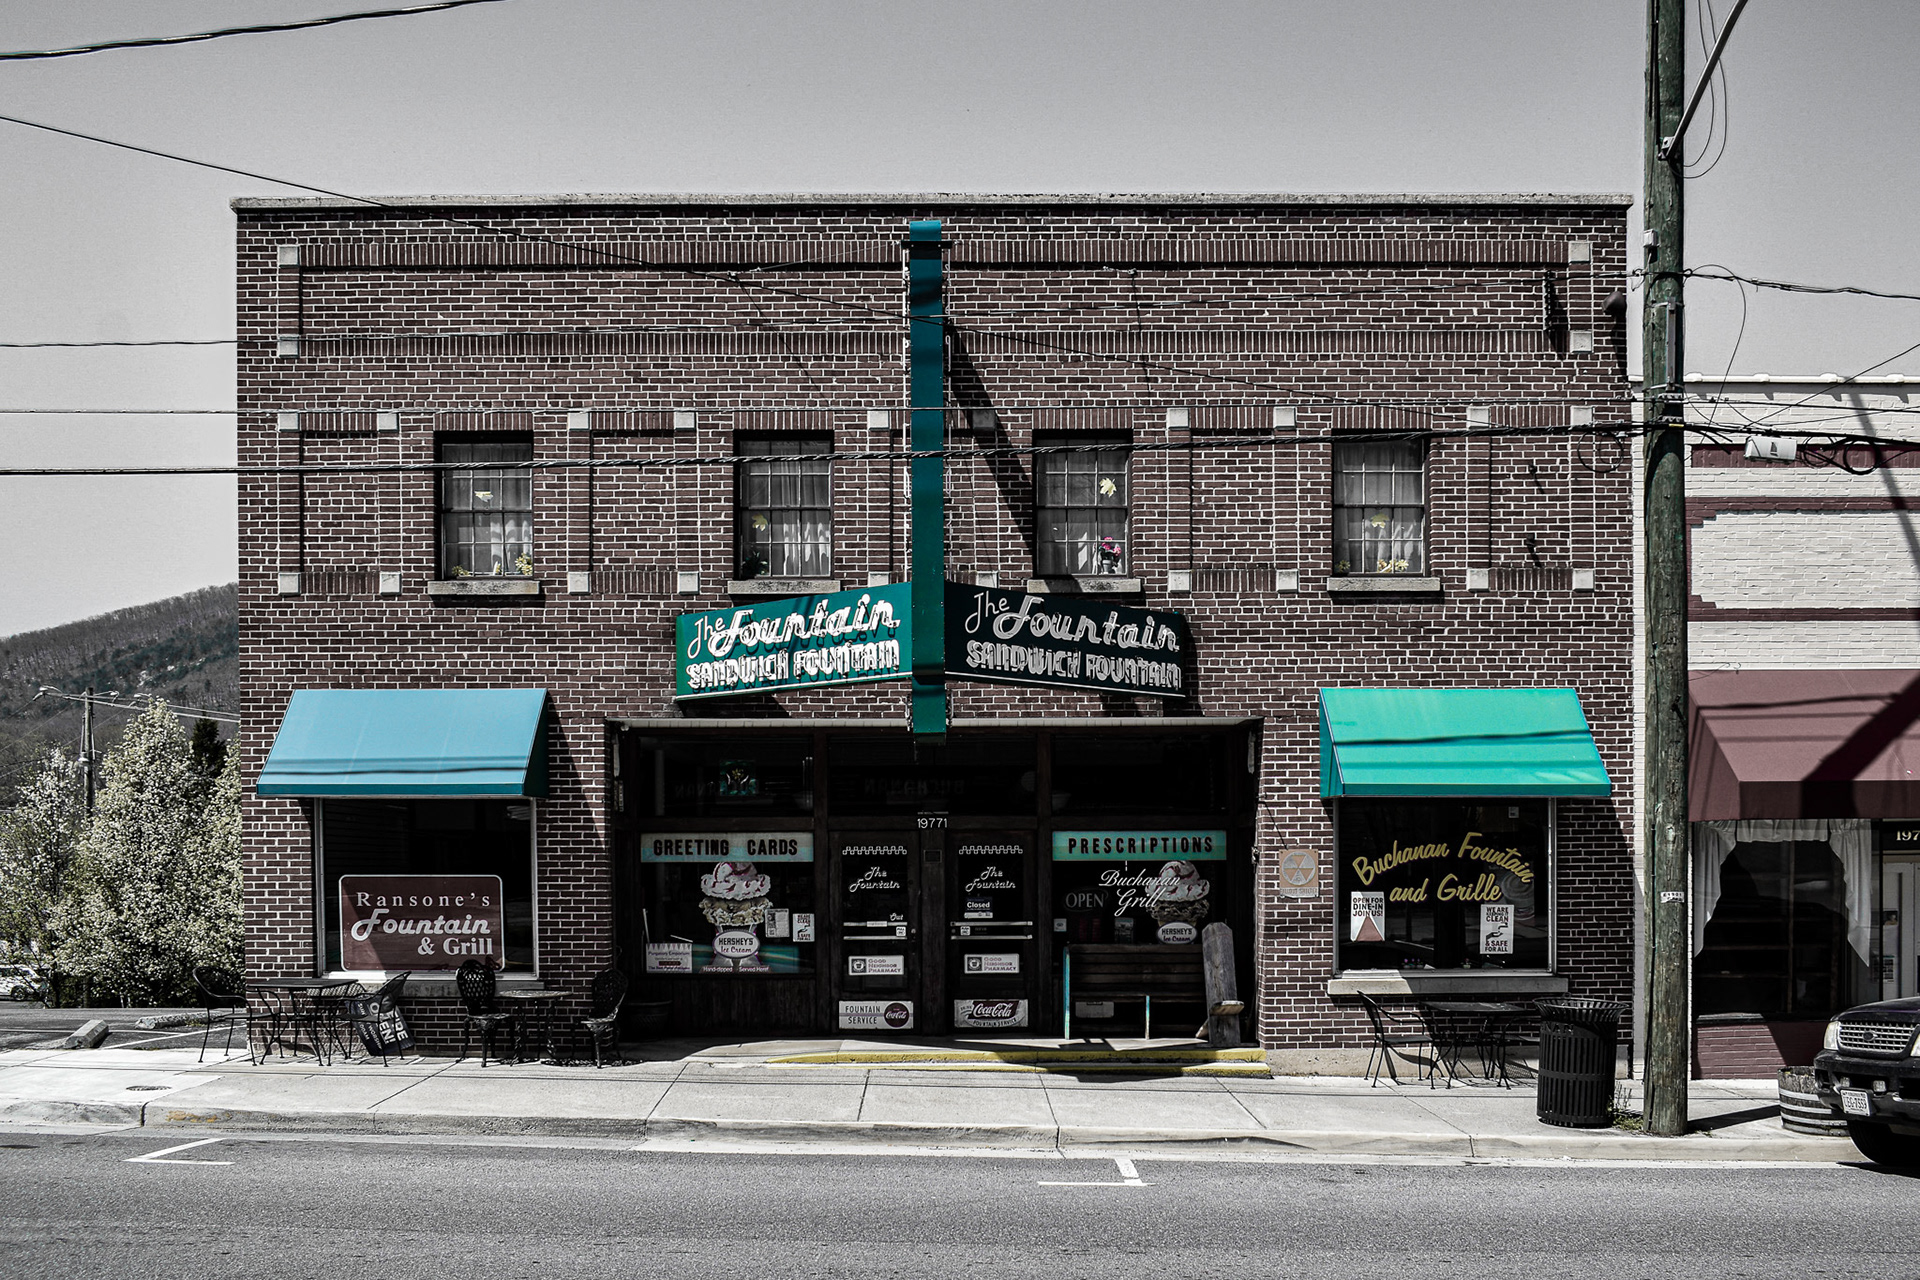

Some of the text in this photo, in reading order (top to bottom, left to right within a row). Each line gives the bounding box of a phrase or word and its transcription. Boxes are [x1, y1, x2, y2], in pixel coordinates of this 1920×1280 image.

[687, 593, 901, 659] The Fountain
[964, 590, 1180, 652] The Fountain
[685, 639, 900, 689] SANDWICH FOUNTAIN
[965, 639, 1182, 690] SANDWICH FOUNTAIN
[917, 817, 948, 829] 19771
[653, 839, 798, 856] GREETING CARDS
[1068, 836, 1213, 854] PRESCRIPTIONS
[1352, 832, 1534, 885] Buchanan Fountain
[865, 866, 887, 880] The
[980, 866, 1004, 880] The
[1098, 868, 1181, 887] Buchanan
[849, 878, 900, 892] Fountain
[965, 878, 1016, 892] Fountain
[1389, 873, 1502, 902] and Grille
[356, 892, 490, 907] Ransone's
[1065, 892, 1104, 908] OPEN
[1114, 887, 1167, 917] Grill
[350, 908, 491, 942] Fountain
[417, 936, 493, 955] & Grill
[718, 937, 753, 946] HERSHEY'S
[845, 1005, 881, 1013] FOUNTAIN
[848, 1016, 877, 1024] SERVICE
